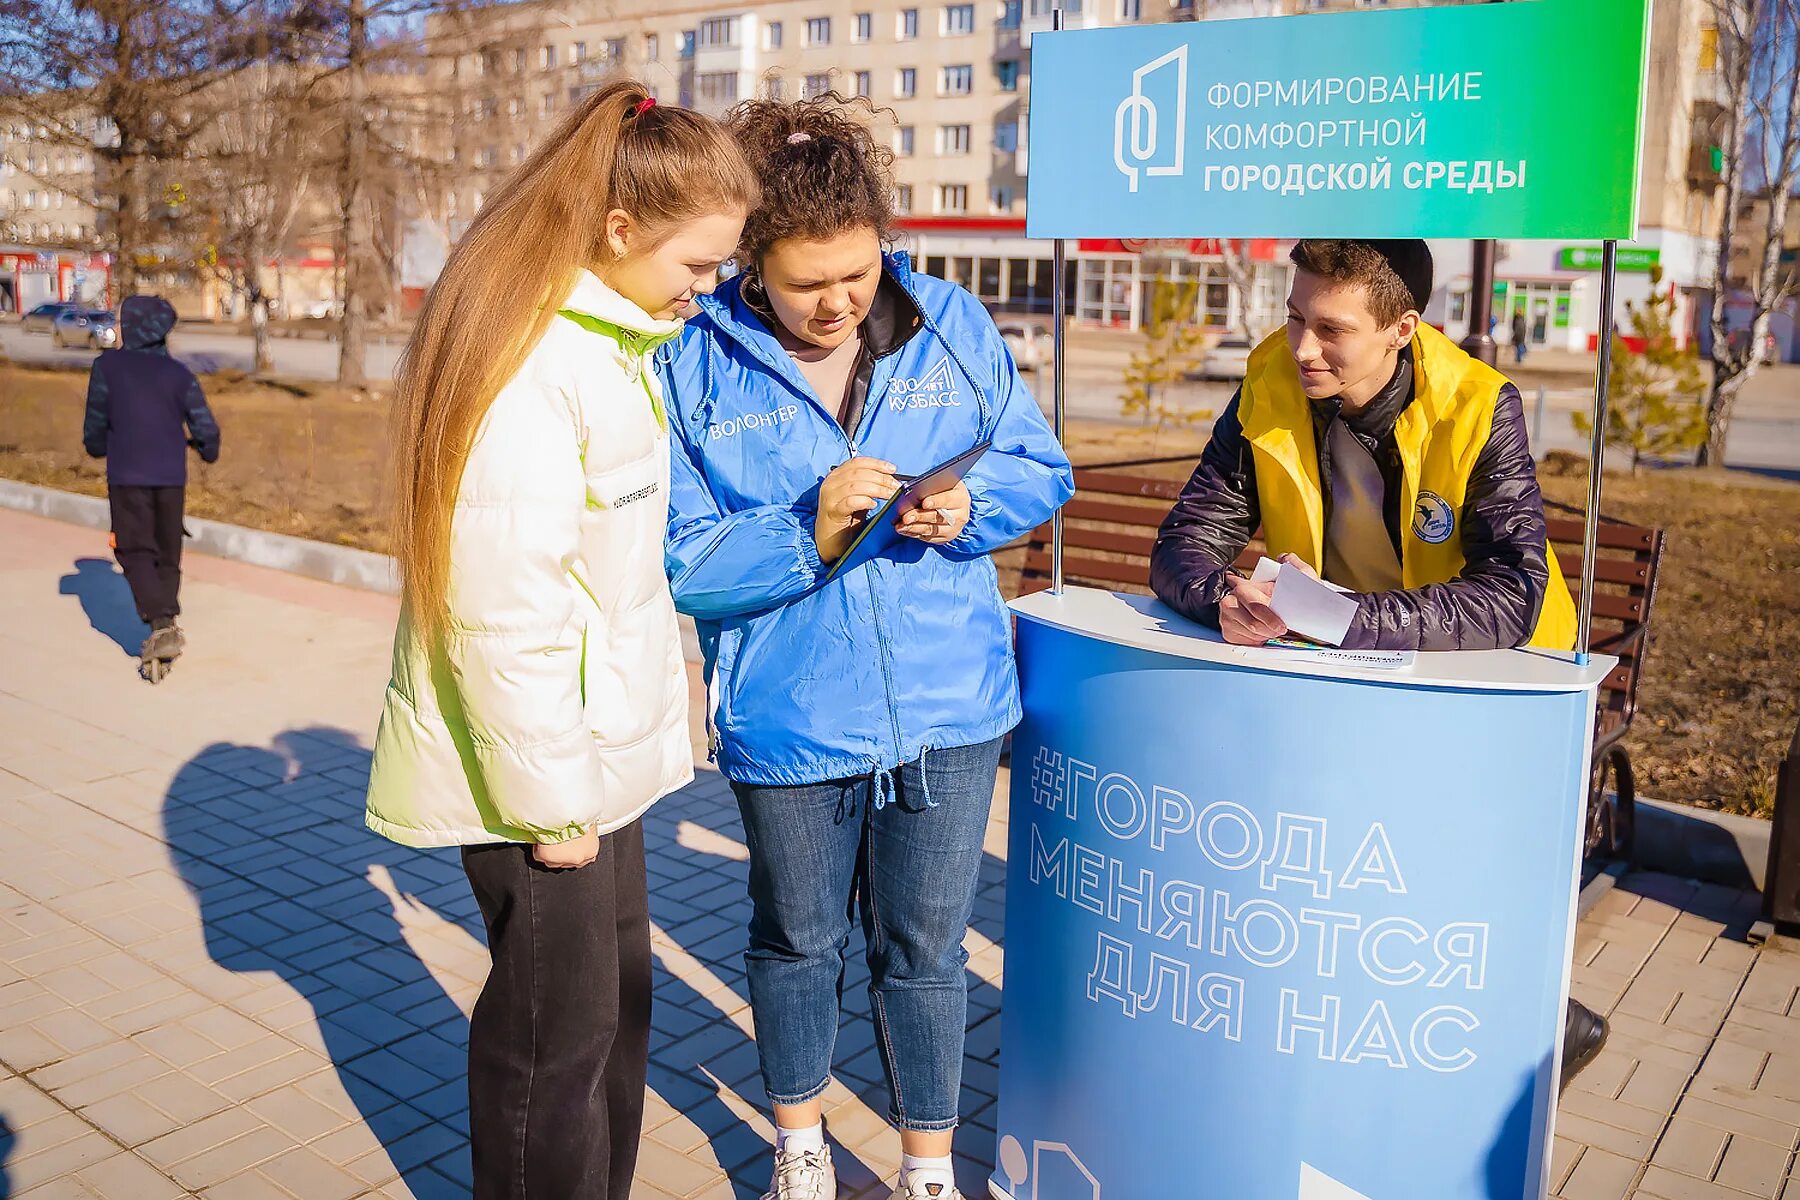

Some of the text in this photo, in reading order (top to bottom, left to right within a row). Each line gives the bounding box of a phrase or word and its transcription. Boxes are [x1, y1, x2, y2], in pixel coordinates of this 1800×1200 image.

[1207, 71, 1483, 109] ФОРМИРОВАНИЕ
[1206, 111, 1426, 150] КОМФОРТНОЙ
[1204, 155, 1526, 196] ГОРОДСКОЙ СРЕДЫ
[888, 377, 918, 395] 300
[888, 390, 961, 412] КУЗБАСС
[709, 404, 798, 440] ВОЛОНТЕР
[1031, 745, 1407, 899] #ГОРОДА
[1029, 822, 1489, 990] МЕНЯЮТСЯ
[1086, 931, 1480, 1073] ДЛЯ НАС
